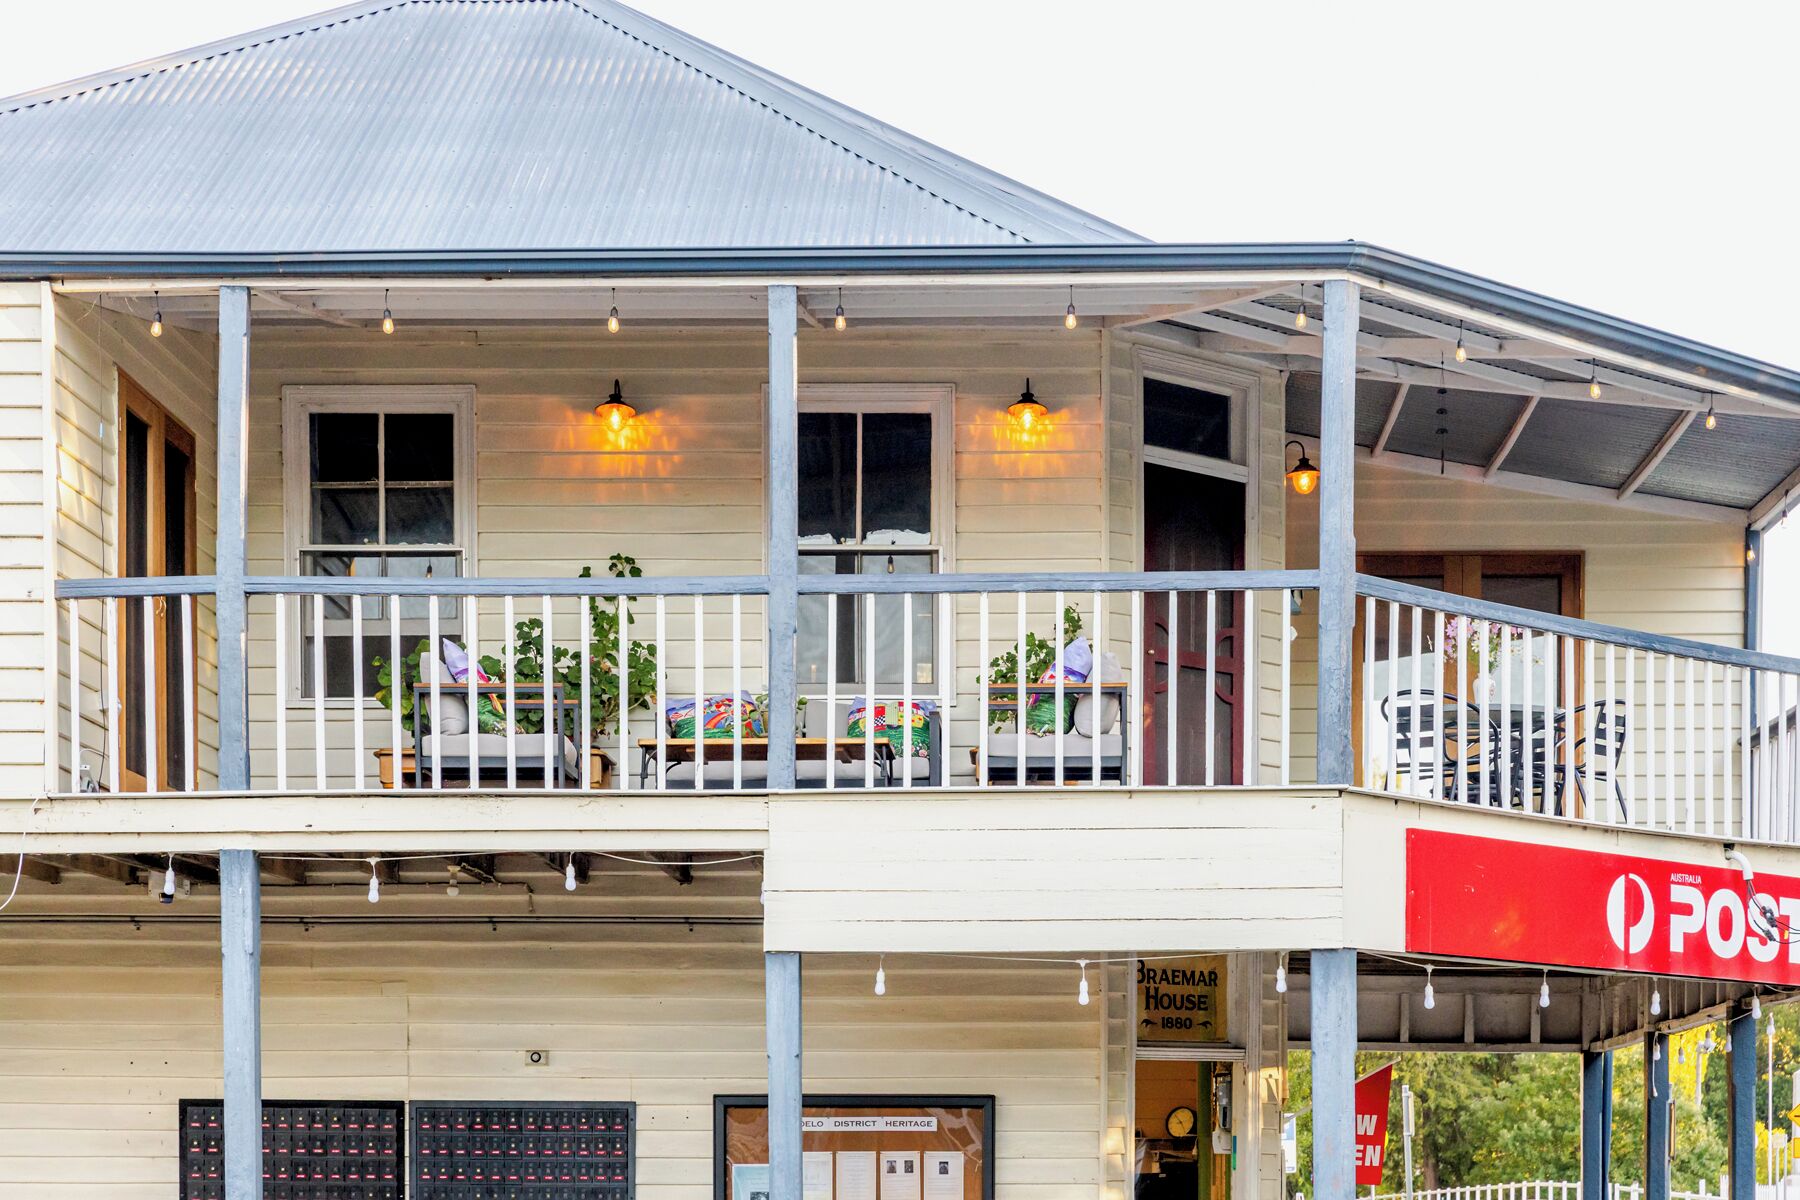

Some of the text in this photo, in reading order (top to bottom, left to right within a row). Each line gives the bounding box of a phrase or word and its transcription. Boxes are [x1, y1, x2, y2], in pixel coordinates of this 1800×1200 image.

[1670, 872, 1702, 884] AUSTRALIA
[1670, 884, 1800, 964] POST
[1137, 958, 1218, 987] BRAEMAR
[1145, 985, 1209, 1012] HOUSE
[1161, 1016, 1193, 1030] 1880
[801, 1120, 933, 1128] DELO DISTRICT HERITAGE
[1356, 1114, 1378, 1136] W
[1355, 1144, 1382, 1166] EN
